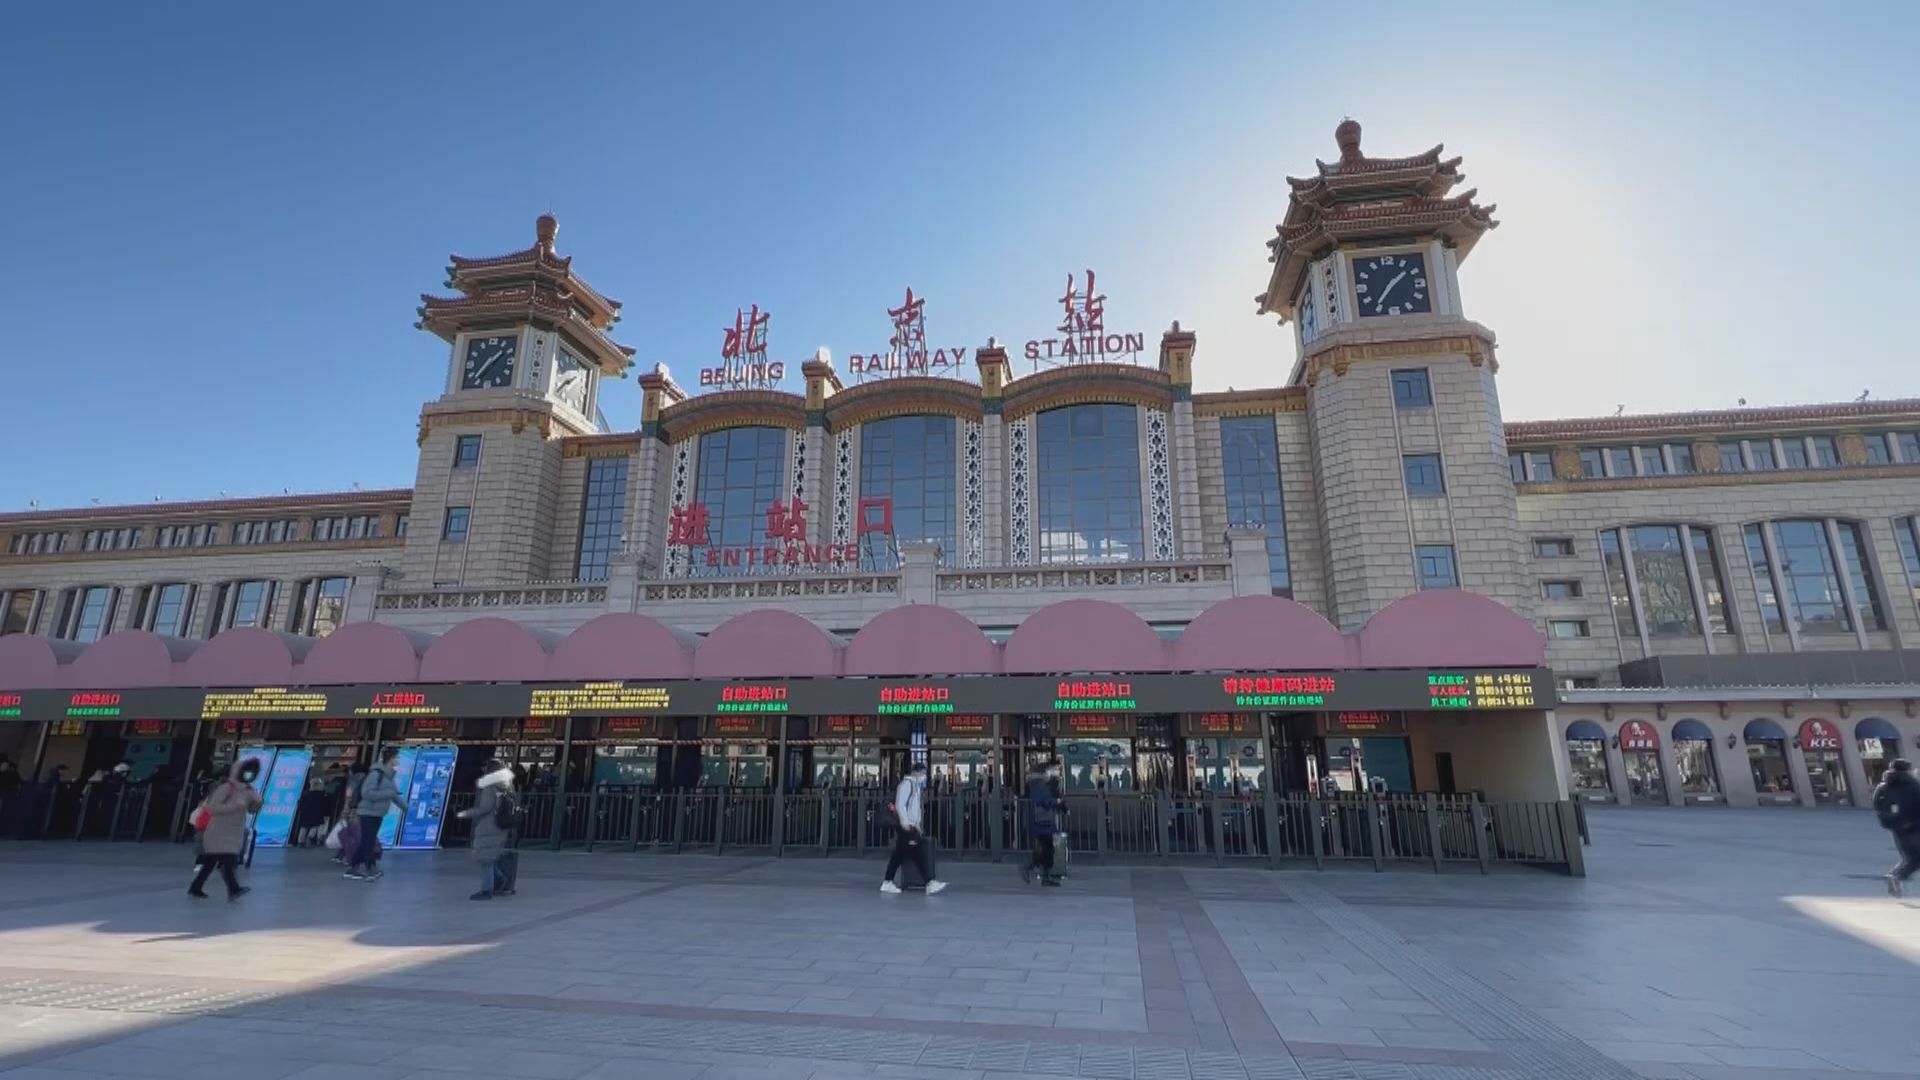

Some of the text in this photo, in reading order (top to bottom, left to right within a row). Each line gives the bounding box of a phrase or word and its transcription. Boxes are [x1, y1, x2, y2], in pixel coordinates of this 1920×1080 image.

[700, 332, 1144, 387] BEIJING RAILWAY STATION
[668, 496, 893, 546] 进站口
[706, 543, 860, 567] ENTRANCE
[1057, 681, 1131, 697] 自助进站口
[1223, 675, 1335, 693] 请持健康码进站
[372, 692, 425, 705] 人工进站口
[722, 686, 787, 701] 自助进站口
[881, 686, 949, 702] 自助进站口
[1810, 738, 1838, 748] KFC
